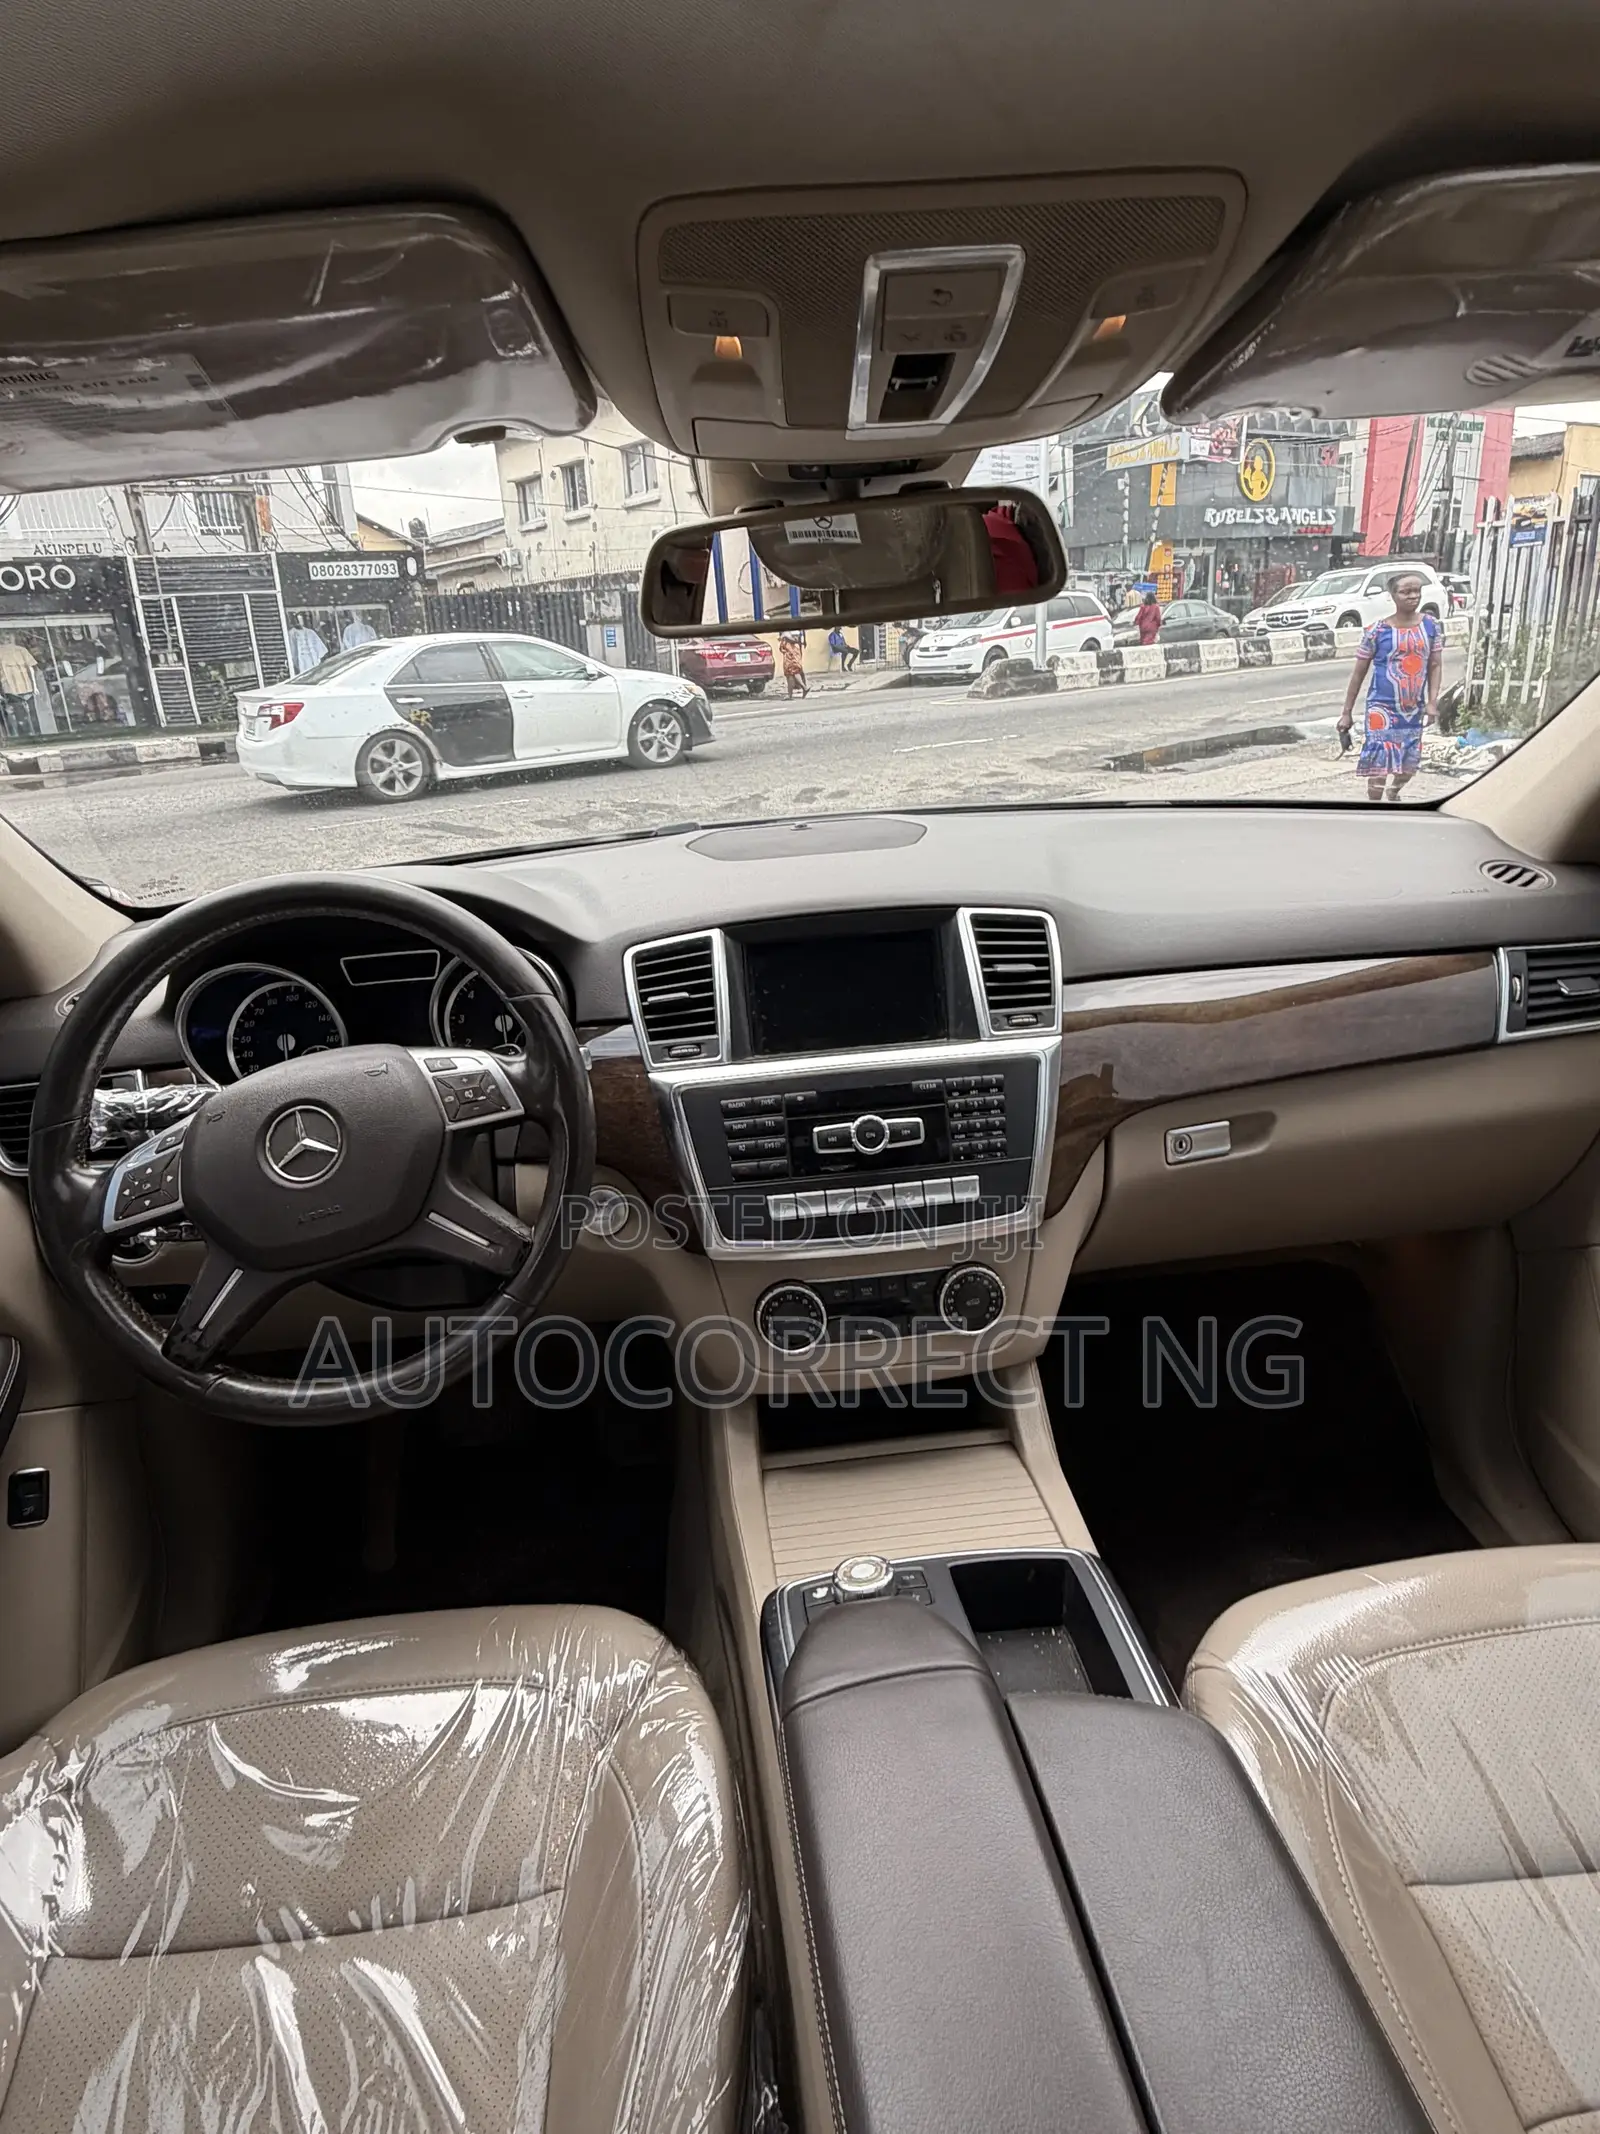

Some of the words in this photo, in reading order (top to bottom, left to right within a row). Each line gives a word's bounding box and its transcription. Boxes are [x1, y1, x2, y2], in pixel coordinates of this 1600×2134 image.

[33, 542, 103, 556] AKINPELU
[311, 563, 397, 577] 08028377093
[468, 990, 475, 999] 4
[305, 1001, 318, 1009] 120
[254, 1008, 264, 1016] 70
[458, 1015, 465, 1024] 3
[240, 1036, 251, 1044] 50
[464, 1038, 472, 1047] 2
